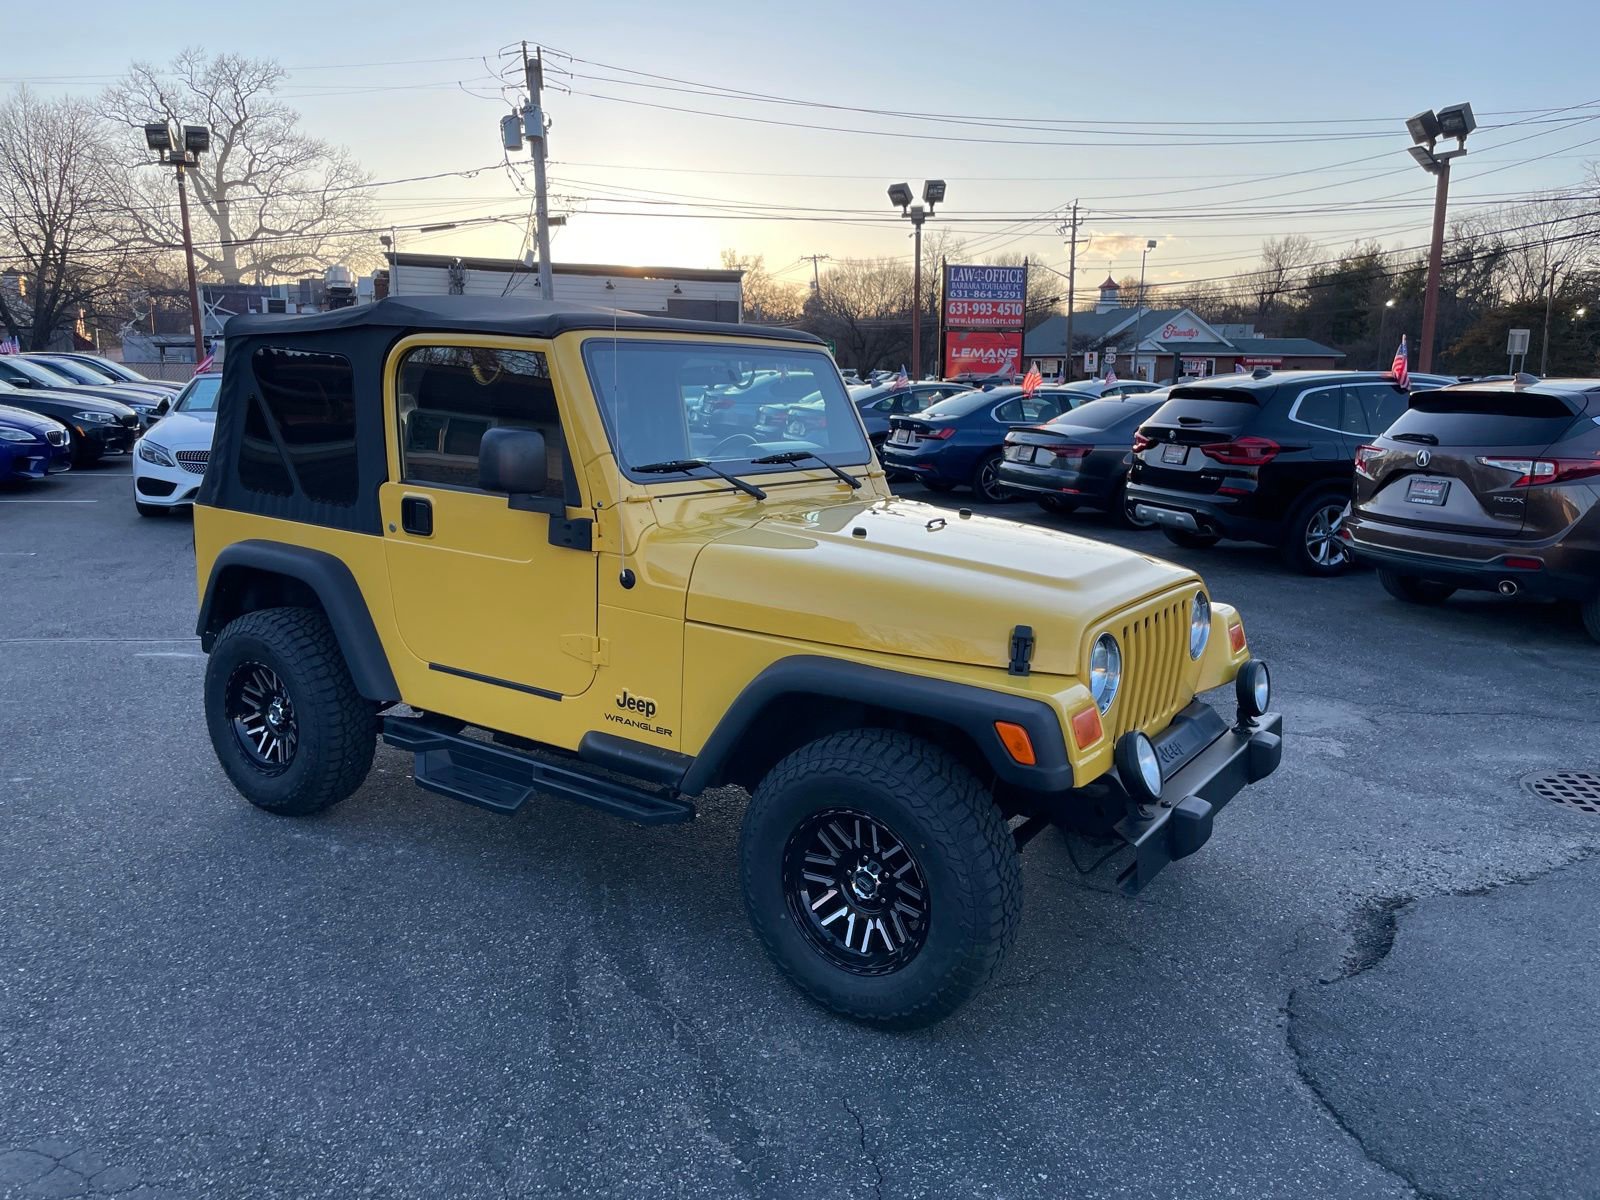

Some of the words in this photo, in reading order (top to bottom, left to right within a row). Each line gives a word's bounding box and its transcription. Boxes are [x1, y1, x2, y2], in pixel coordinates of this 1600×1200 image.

[950, 268, 975, 281] LAW
[984, 269, 1023, 283] OFFICE
[950, 290, 1021, 298] 631-864-5291
[949, 303, 1022, 315] 631-993-4510
[949, 317, 1021, 325] www.LemansCars.com
[951, 348, 1018, 358] LEMANS
[1493, 495, 1524, 505] RDX
[615, 690, 657, 718] Jeep
[604, 713, 673, 737] WRANGLER
